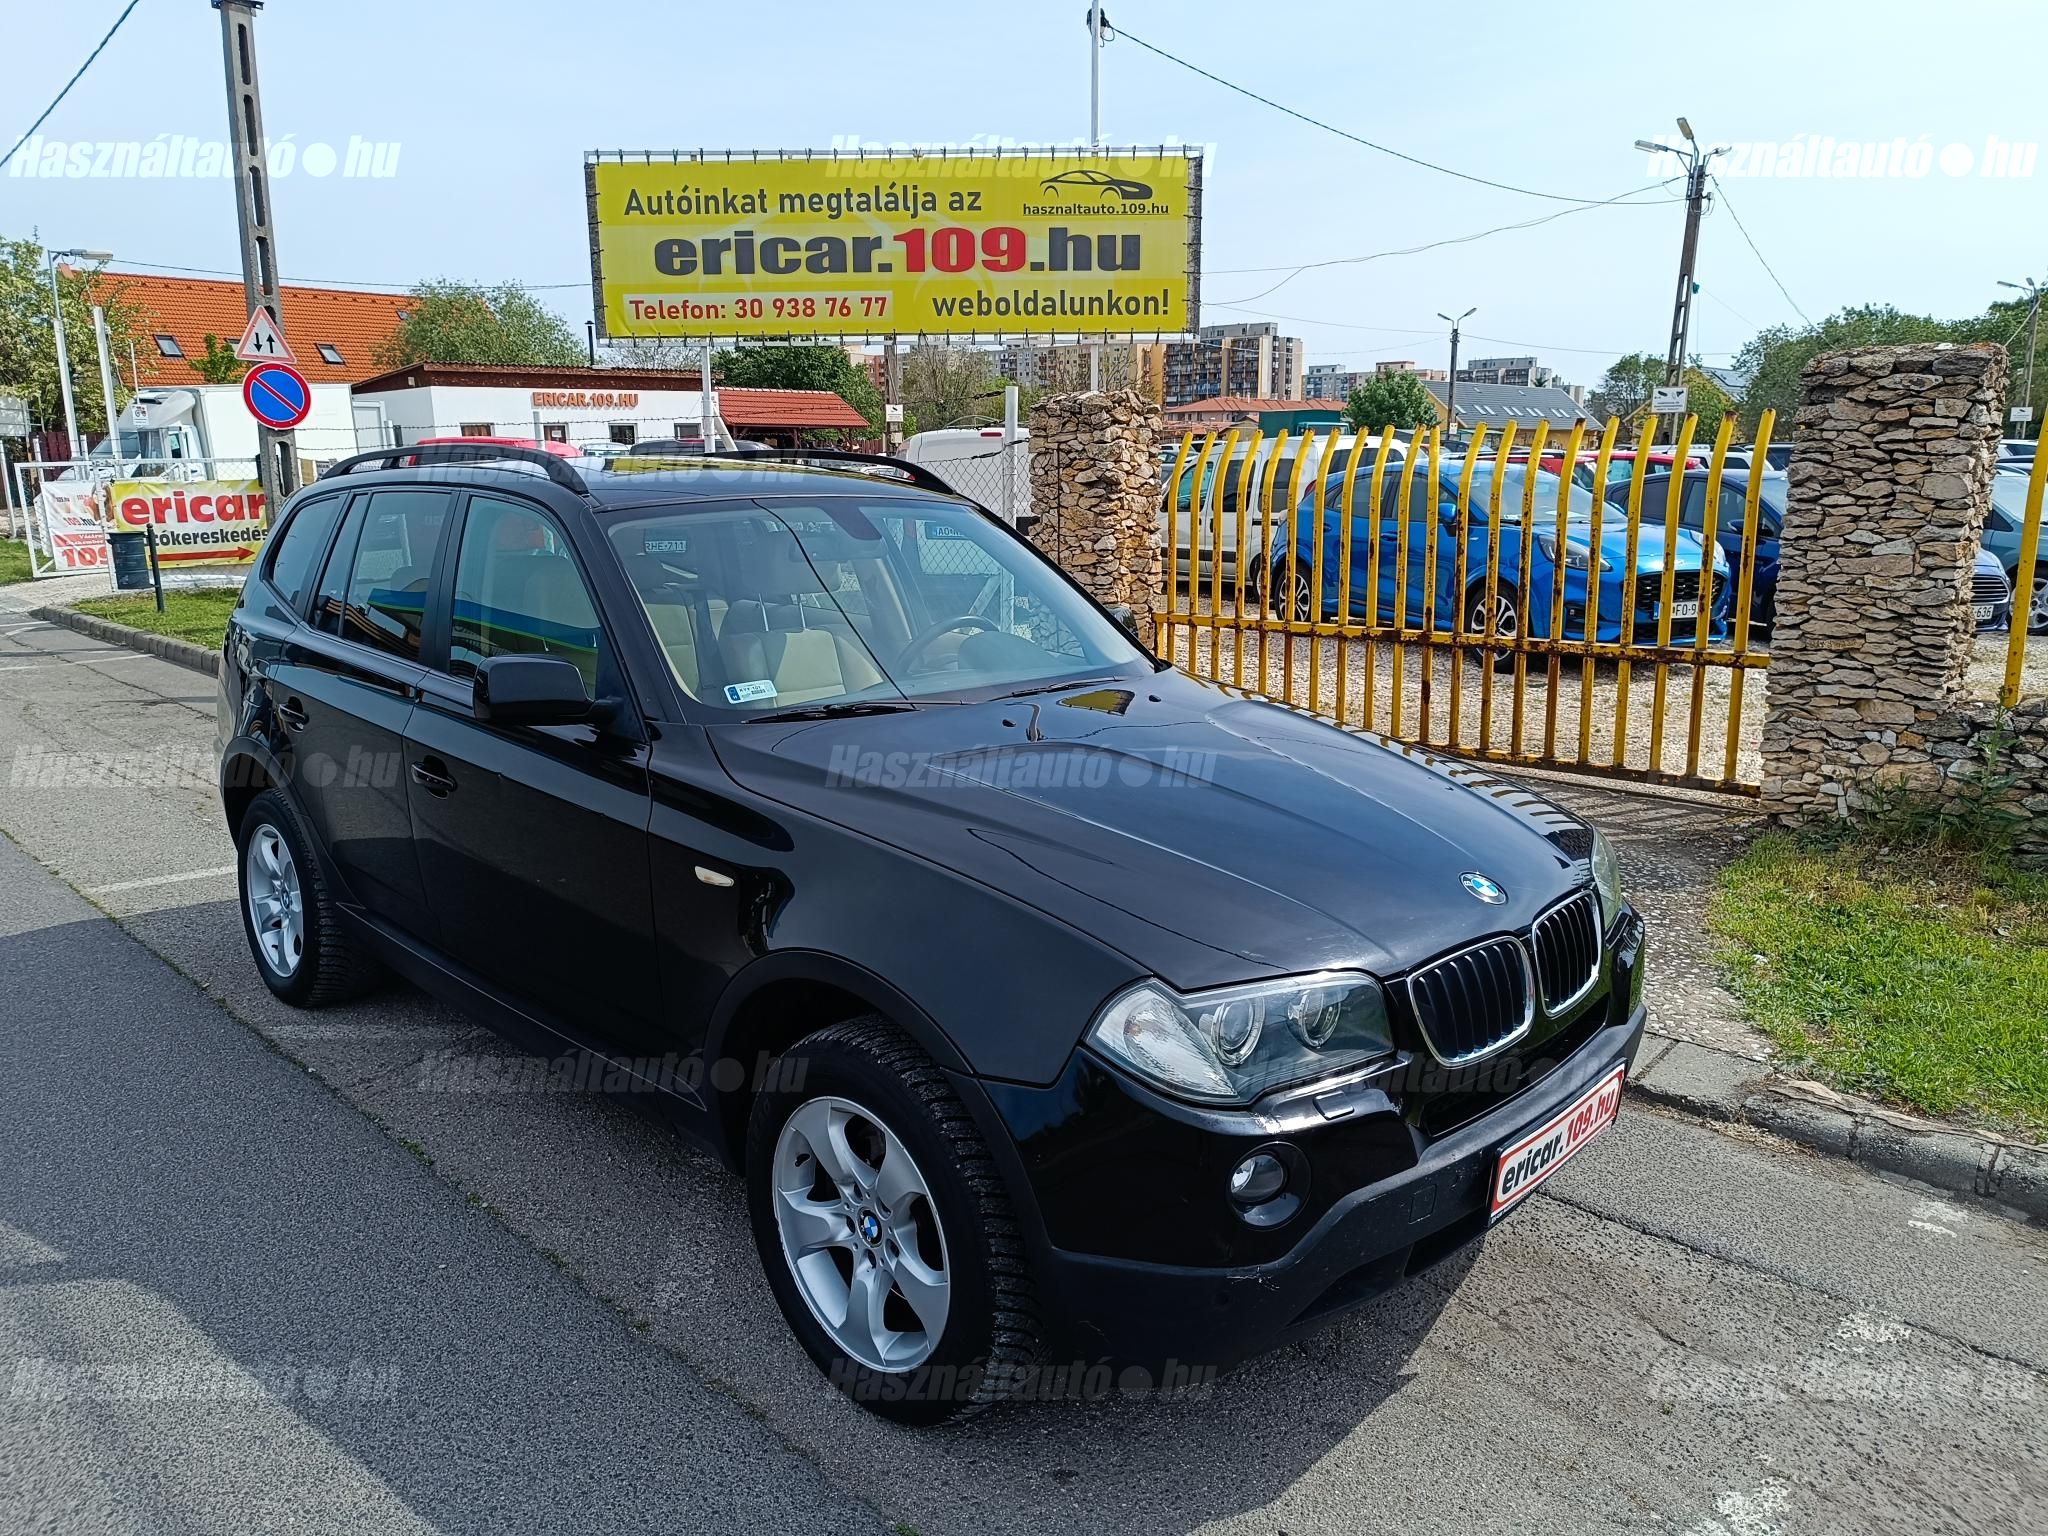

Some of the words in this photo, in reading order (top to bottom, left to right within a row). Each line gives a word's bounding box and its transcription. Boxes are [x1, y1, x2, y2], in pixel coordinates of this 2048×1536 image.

[624, 184, 768, 216] Autóinkat
[779, 181, 937, 219] megtalálja
[948, 191, 982, 212] az
[1022, 203, 1169, 216] hasznaltauto.109.hu
[654, 226, 1141, 276] ericar.109.hu
[629, 299, 726, 320] Telefon:
[734, 298, 763, 319] 30
[773, 297, 816, 318] 938
[825, 296, 852, 318] 76
[860, 296, 887, 317] 77
[932, 288, 1169, 317] weboldalunkon!
[532, 391, 639, 409] ERICAR.109.HU
[121, 491, 266, 526] ericar
[1502, 1087, 1616, 1196] ericar.109.hu
